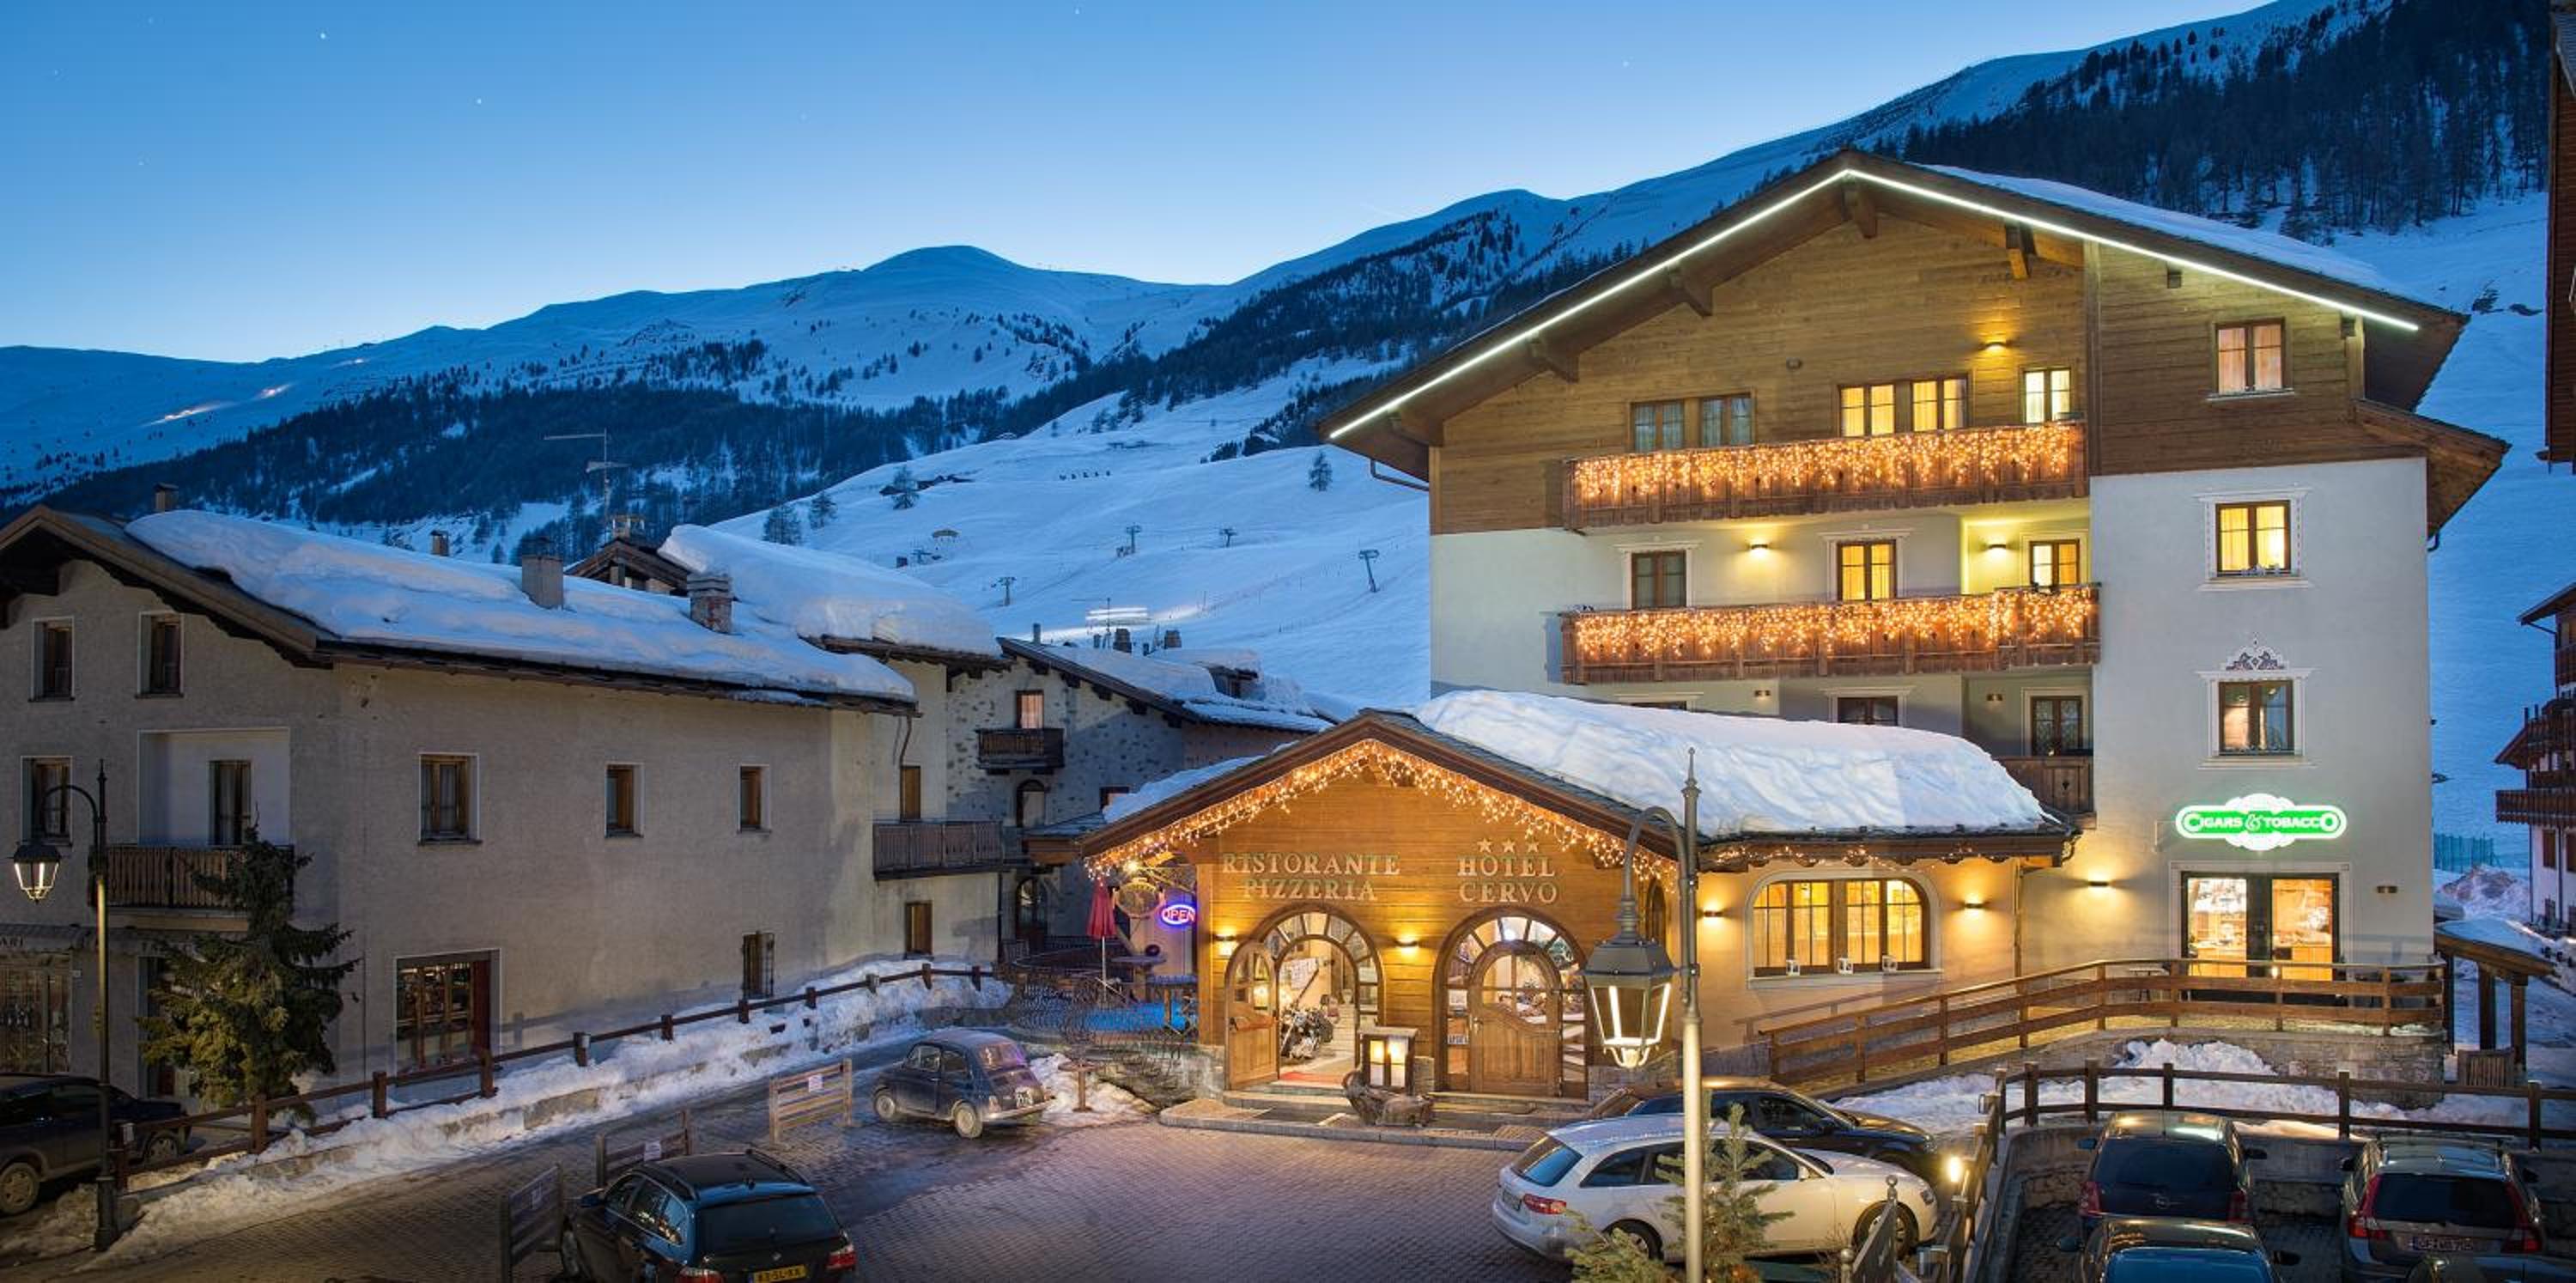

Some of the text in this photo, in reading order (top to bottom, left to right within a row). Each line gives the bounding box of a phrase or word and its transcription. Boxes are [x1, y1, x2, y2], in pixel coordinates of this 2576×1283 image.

[2184, 812, 2338, 832] CIGARS & TOBACCO
[1222, 854, 1400, 876] RISTORANTE
[1457, 854, 1555, 877] HOTEL
[1243, 877, 1378, 901] PIZZERIA
[1459, 881, 1558, 903] CERVO
[1162, 909, 1195, 921] OPEN
